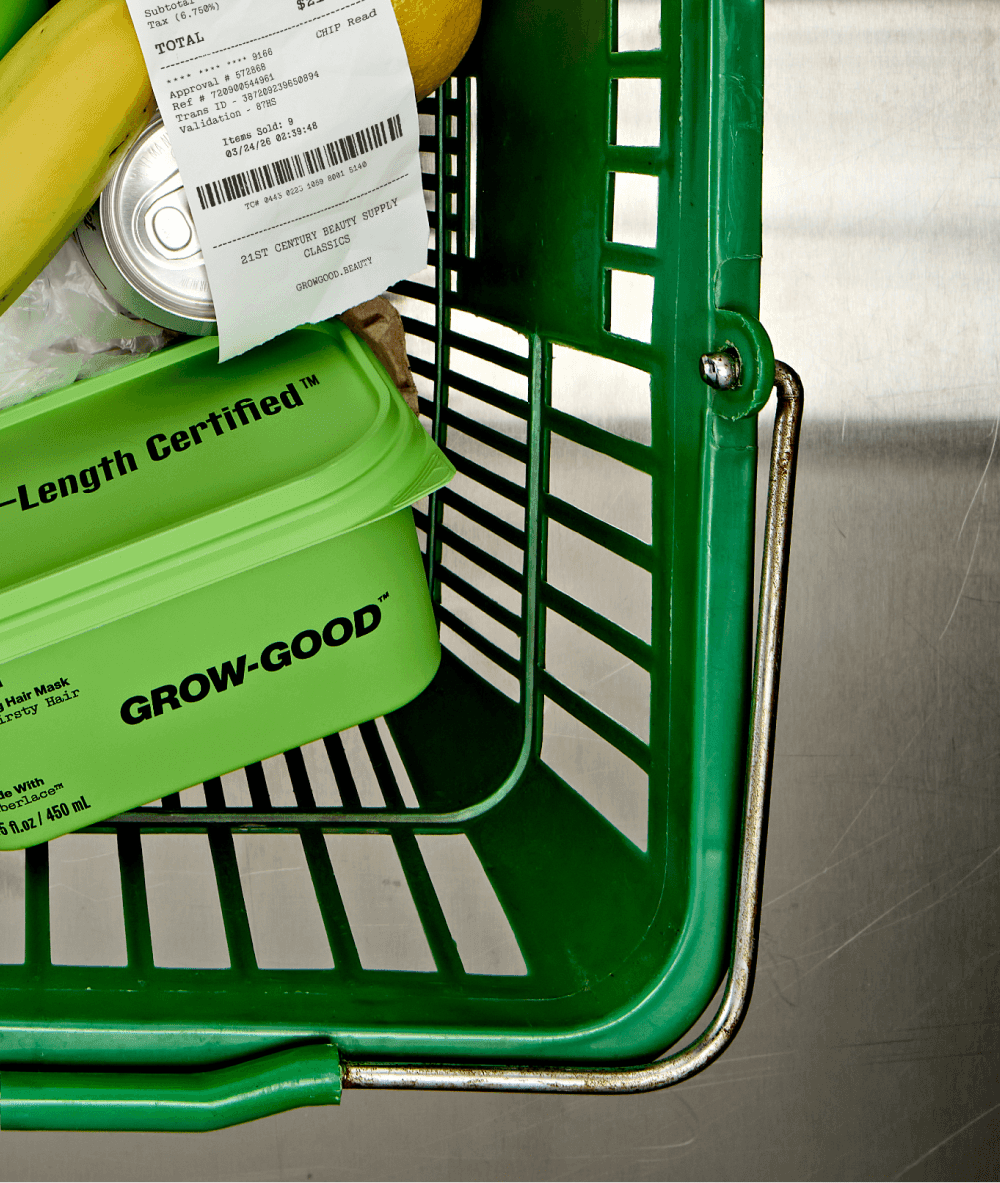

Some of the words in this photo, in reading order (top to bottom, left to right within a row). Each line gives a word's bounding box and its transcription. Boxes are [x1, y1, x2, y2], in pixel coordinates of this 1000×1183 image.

[146, 18, 169, 30] Tax
[175, 1, 220, 23] (6.750%)
[154, 31, 205, 55] TOTAL
[251, 47, 273, 61] 9166
[315, 22, 341, 39] CHIP
[346, 7, 378, 27] Read
[178, 110, 242, 134] Validation
[221, 132, 253, 147] Items
[256, 121, 283, 136] Sold:
[225, 136, 272, 158] 03/24/26
[275, 121, 319, 143] 02:39:48
[240, 247, 269, 265] 21ST
[274, 230, 318, 253] CENTURY
[321, 215, 357, 237] BEAUTY
[361, 197, 398, 221] SUPPLY
[303, 233, 351, 259] CLASSICS
[295, 256, 373, 292] GROWGOOD.BEAUTY
[4, 691, 32, 708] Hair
[33, 677, 70, 697] Mask
[44, 689, 80, 707] Hair
[12, 777, 45, 794] With
[46, 802, 70, 821] 450
[71, 795, 91, 813] mL
